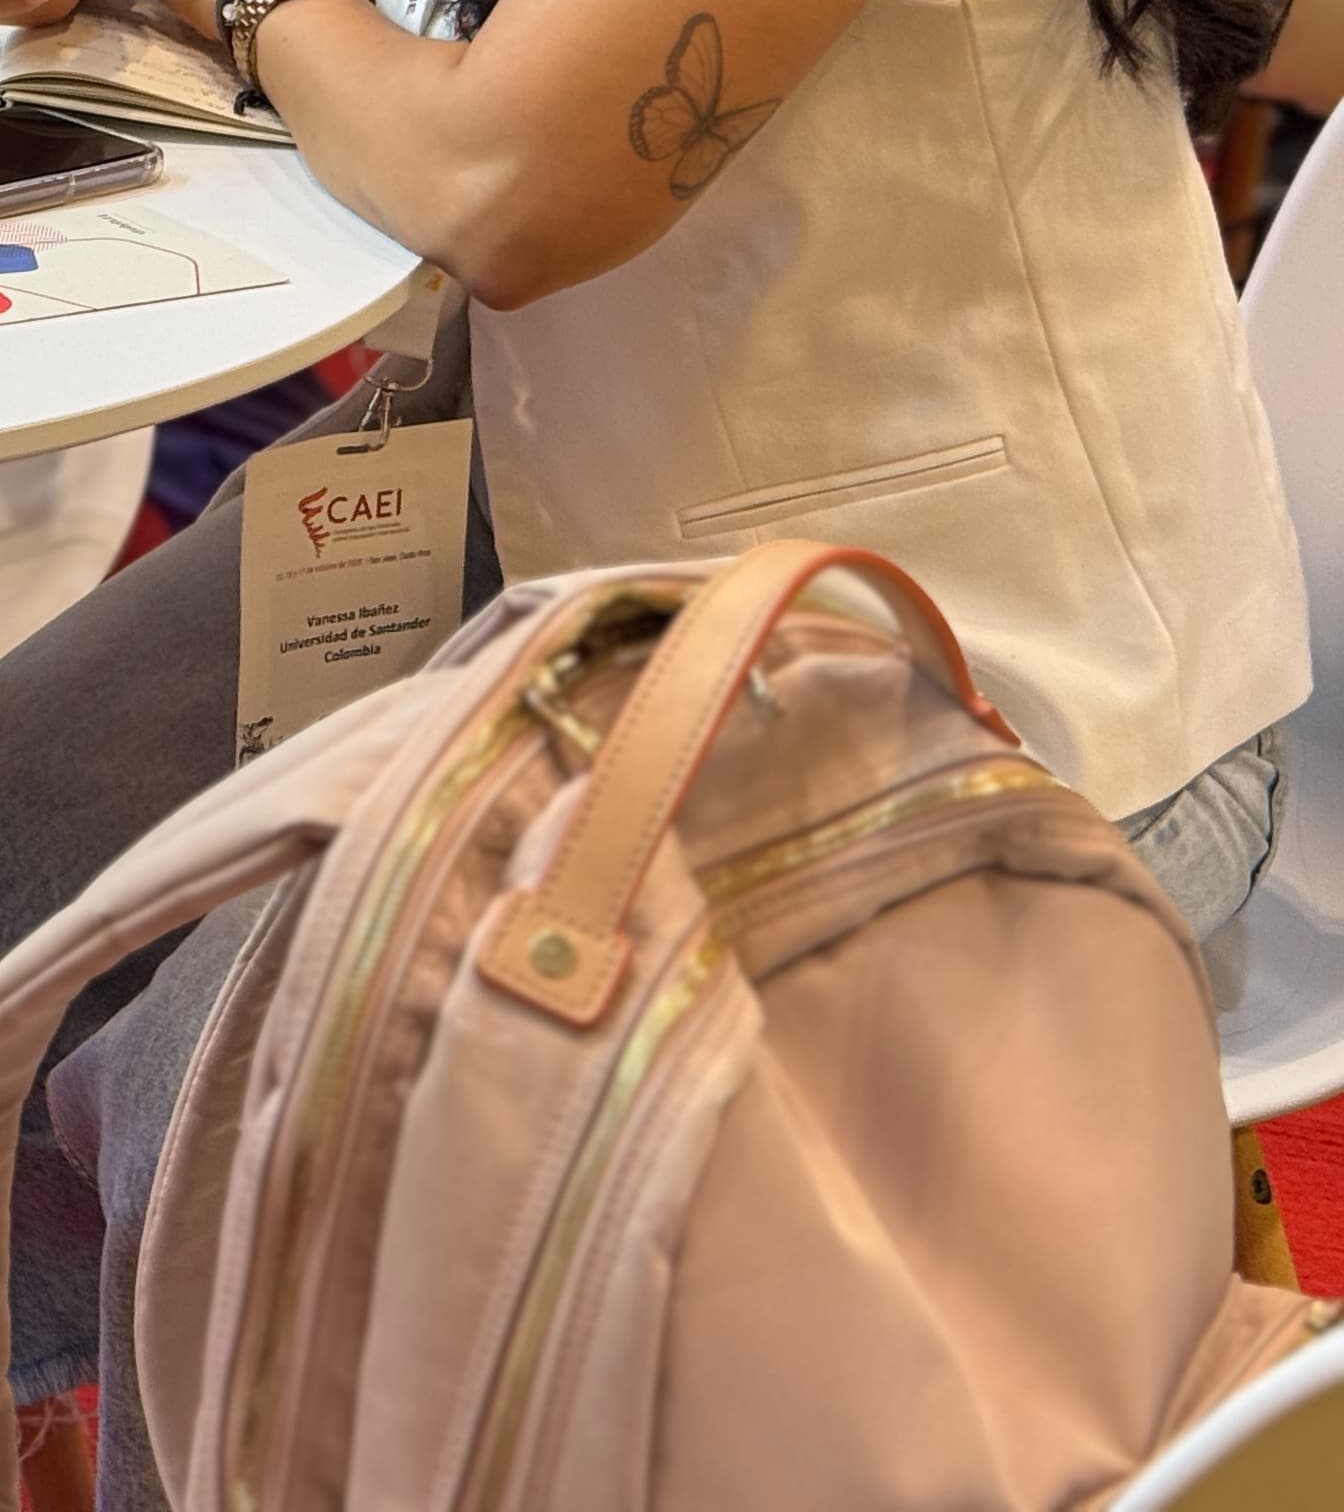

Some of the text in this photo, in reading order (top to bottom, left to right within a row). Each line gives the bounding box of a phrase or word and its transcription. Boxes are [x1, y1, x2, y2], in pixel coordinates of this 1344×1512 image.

[327, 488, 403, 524] CAEI
[307, 610, 356, 628] Vanessa
[280, 615, 432, 654] Universidad de Santander
[323, 643, 382, 664] Colombia
